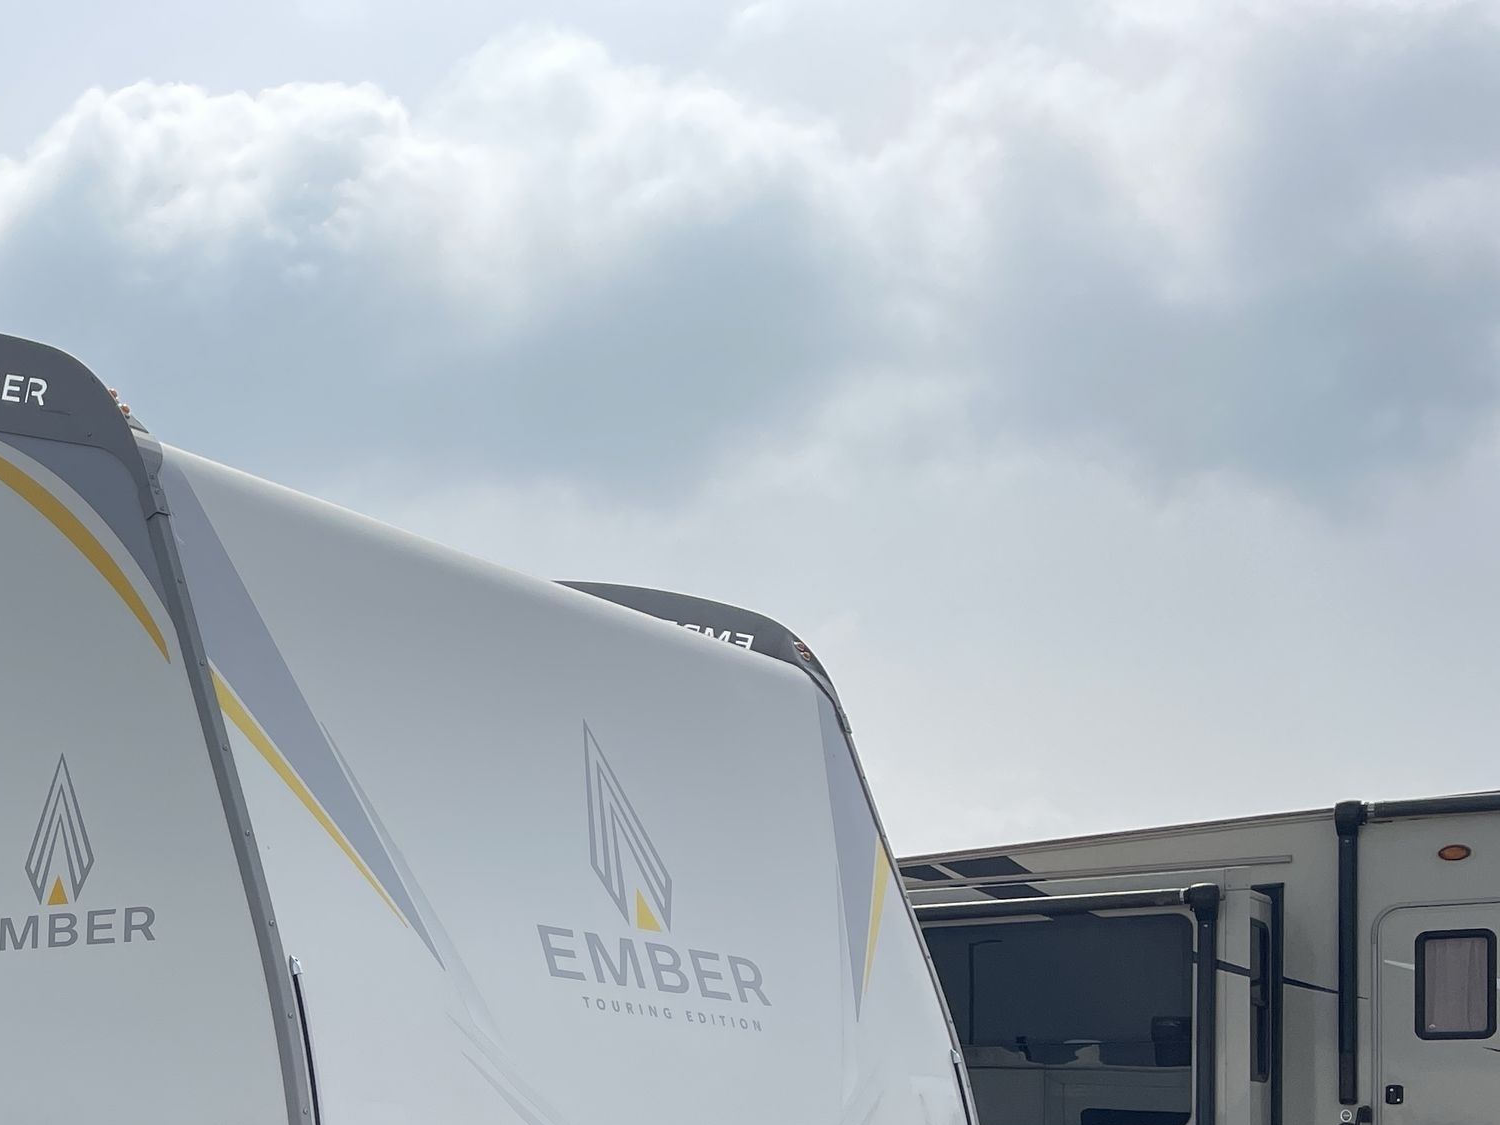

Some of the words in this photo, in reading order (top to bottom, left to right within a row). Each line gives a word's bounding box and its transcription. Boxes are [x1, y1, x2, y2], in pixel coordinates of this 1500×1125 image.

[536, 924, 773, 1007] EMBER
[582, 996, 674, 1019] TOURING
[685, 1010, 763, 1032] EDITION
